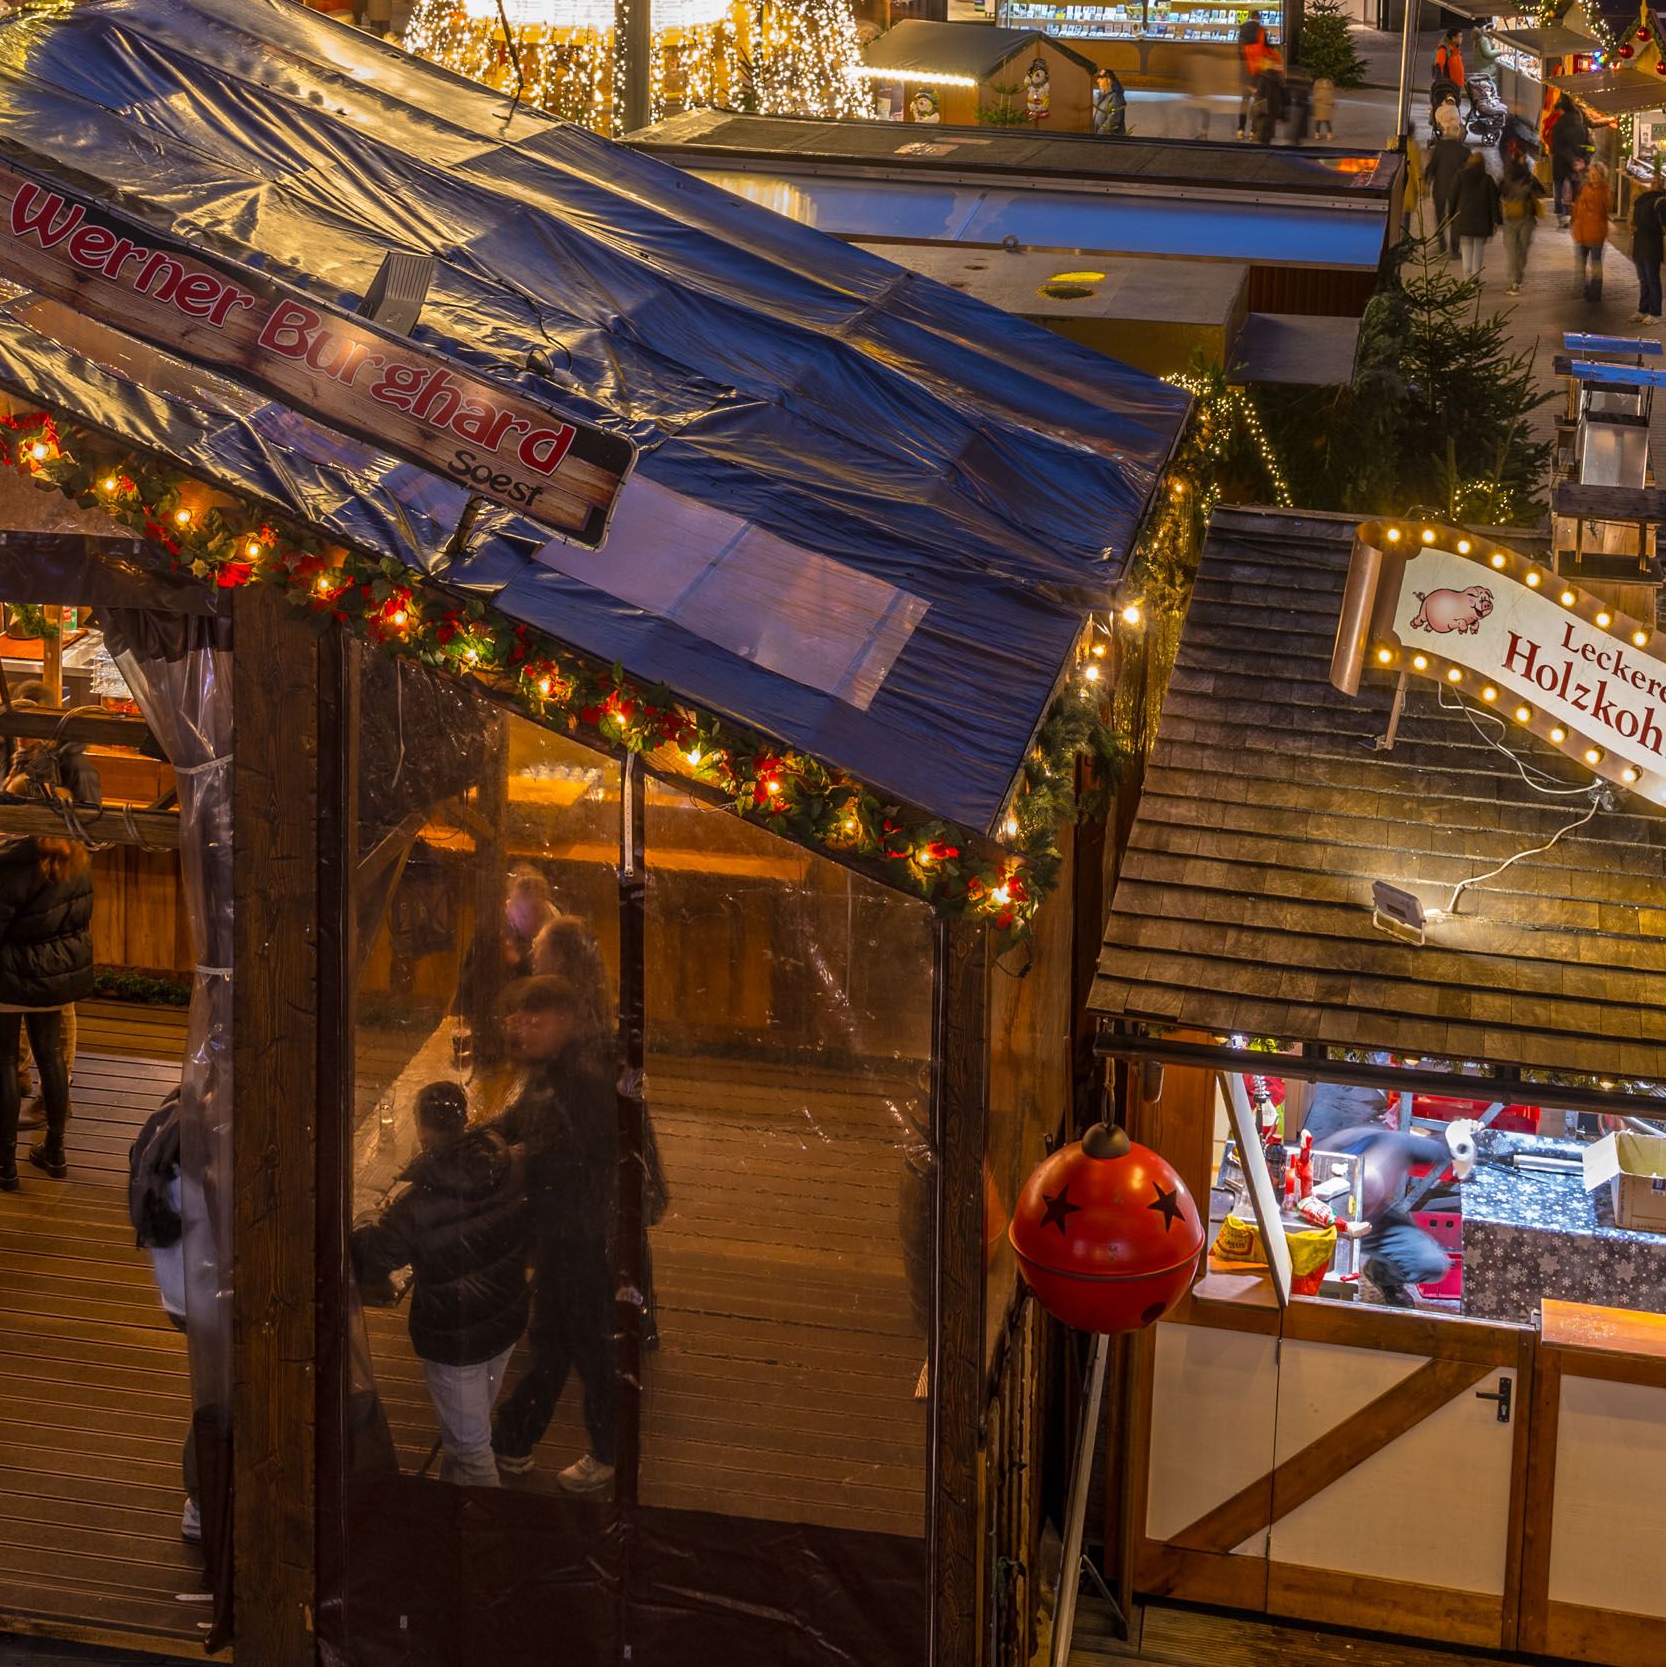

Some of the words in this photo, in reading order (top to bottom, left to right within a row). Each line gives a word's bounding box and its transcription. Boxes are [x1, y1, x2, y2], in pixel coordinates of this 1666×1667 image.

[9, 181, 255, 329] Werner
[257, 297, 579, 478] Burghard
[447, 449, 543, 510] Soest
